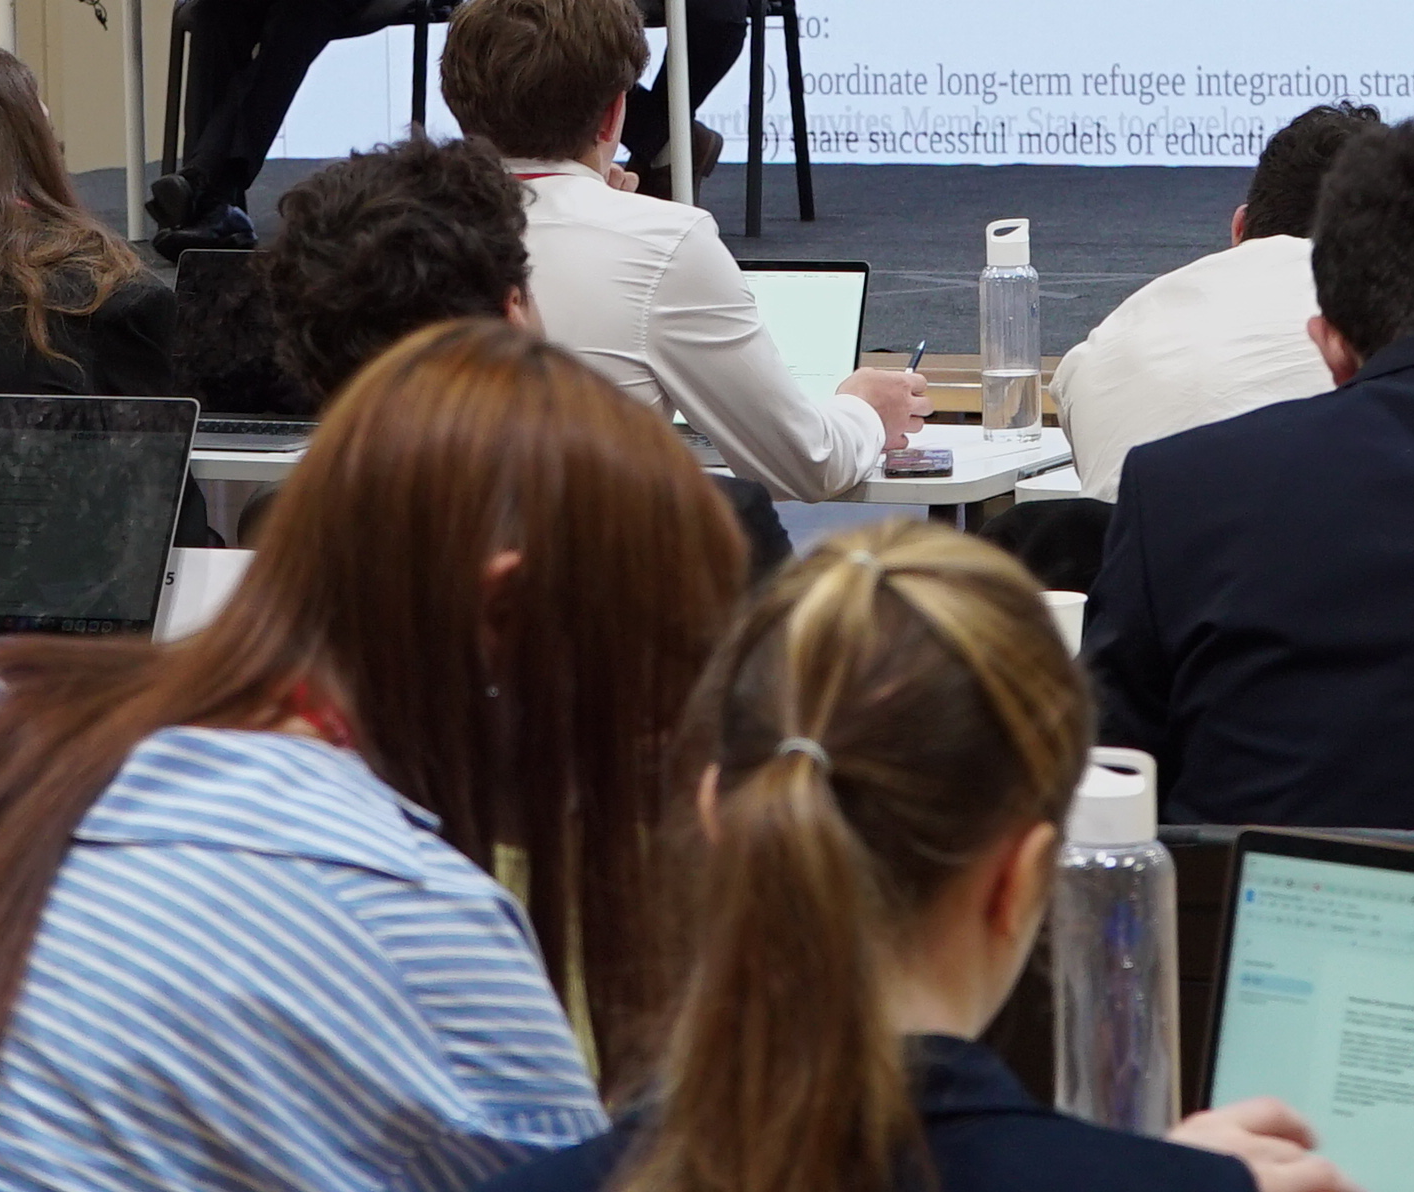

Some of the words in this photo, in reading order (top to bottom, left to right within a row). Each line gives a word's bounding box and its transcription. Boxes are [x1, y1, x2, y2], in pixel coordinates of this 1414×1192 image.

[801, 63, 928, 96] oordinate
[937, 63, 1072, 103] long-term
[1082, 64, 1185, 105] refugee
[1196, 66, 1348, 106] integration
[869, 121, 1007, 155] successful
[1017, 122, 1116, 156] models
[1127, 122, 1157, 156] of
